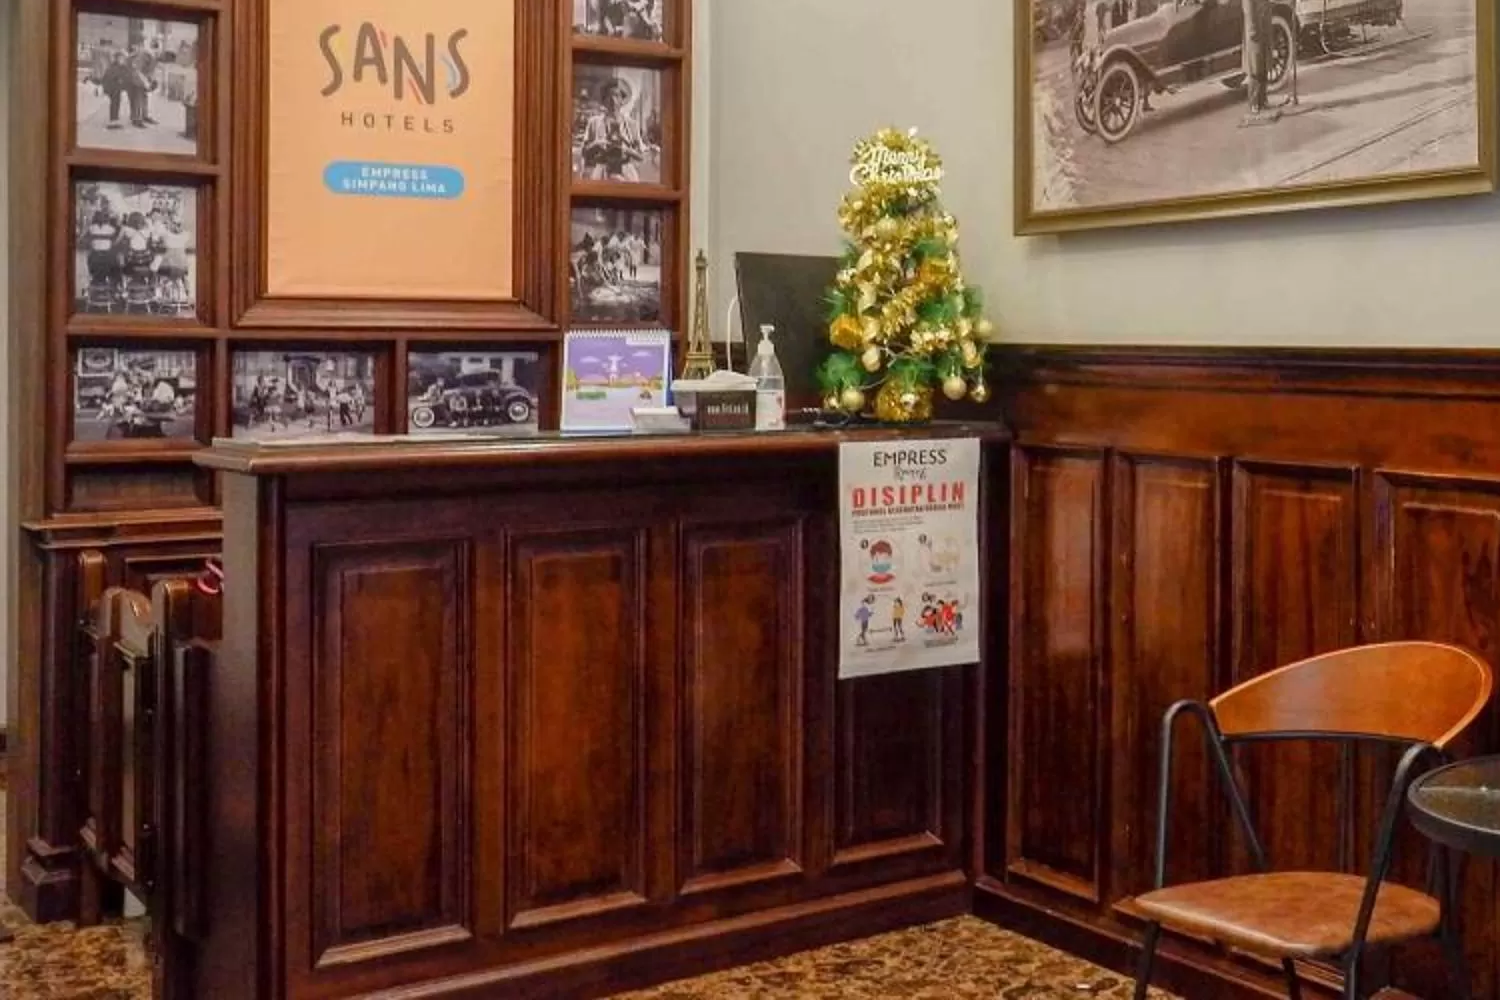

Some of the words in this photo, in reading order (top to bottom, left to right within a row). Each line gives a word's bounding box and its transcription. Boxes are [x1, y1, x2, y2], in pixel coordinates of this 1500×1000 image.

[319, 21, 470, 105] SANS
[341, 112, 454, 133] HOTELS
[361, 166, 428, 180] EMPRESS
[412, 182, 447, 195] LIMA
[873, 449, 948, 467] EMPRESS
[852, 481, 965, 508] DISIPLIN
